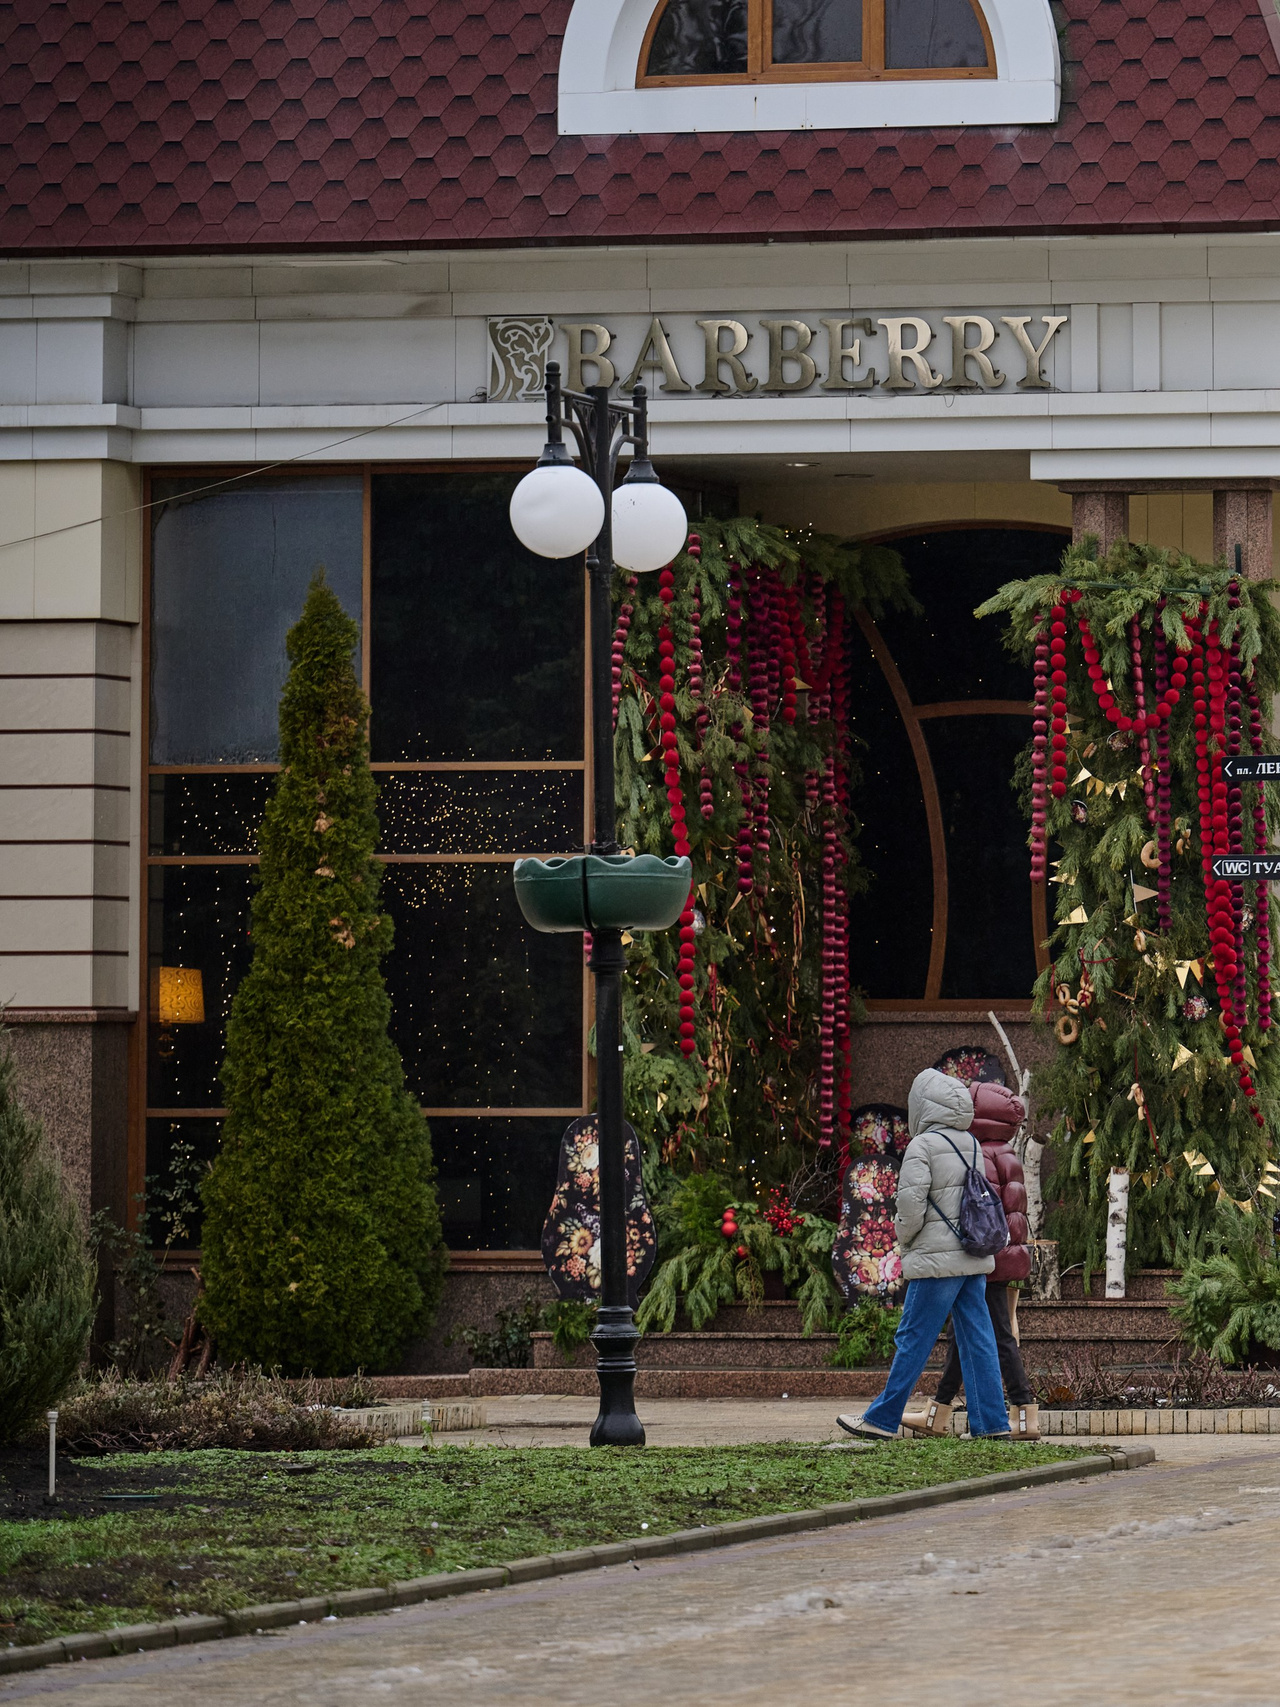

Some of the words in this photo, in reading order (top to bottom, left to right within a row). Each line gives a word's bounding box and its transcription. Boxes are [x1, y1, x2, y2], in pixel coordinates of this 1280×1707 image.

[559, 315, 1069, 392] BARBERRY
[1236, 767, 1252, 775] пл.
[1224, 862, 1248, 874] WC
